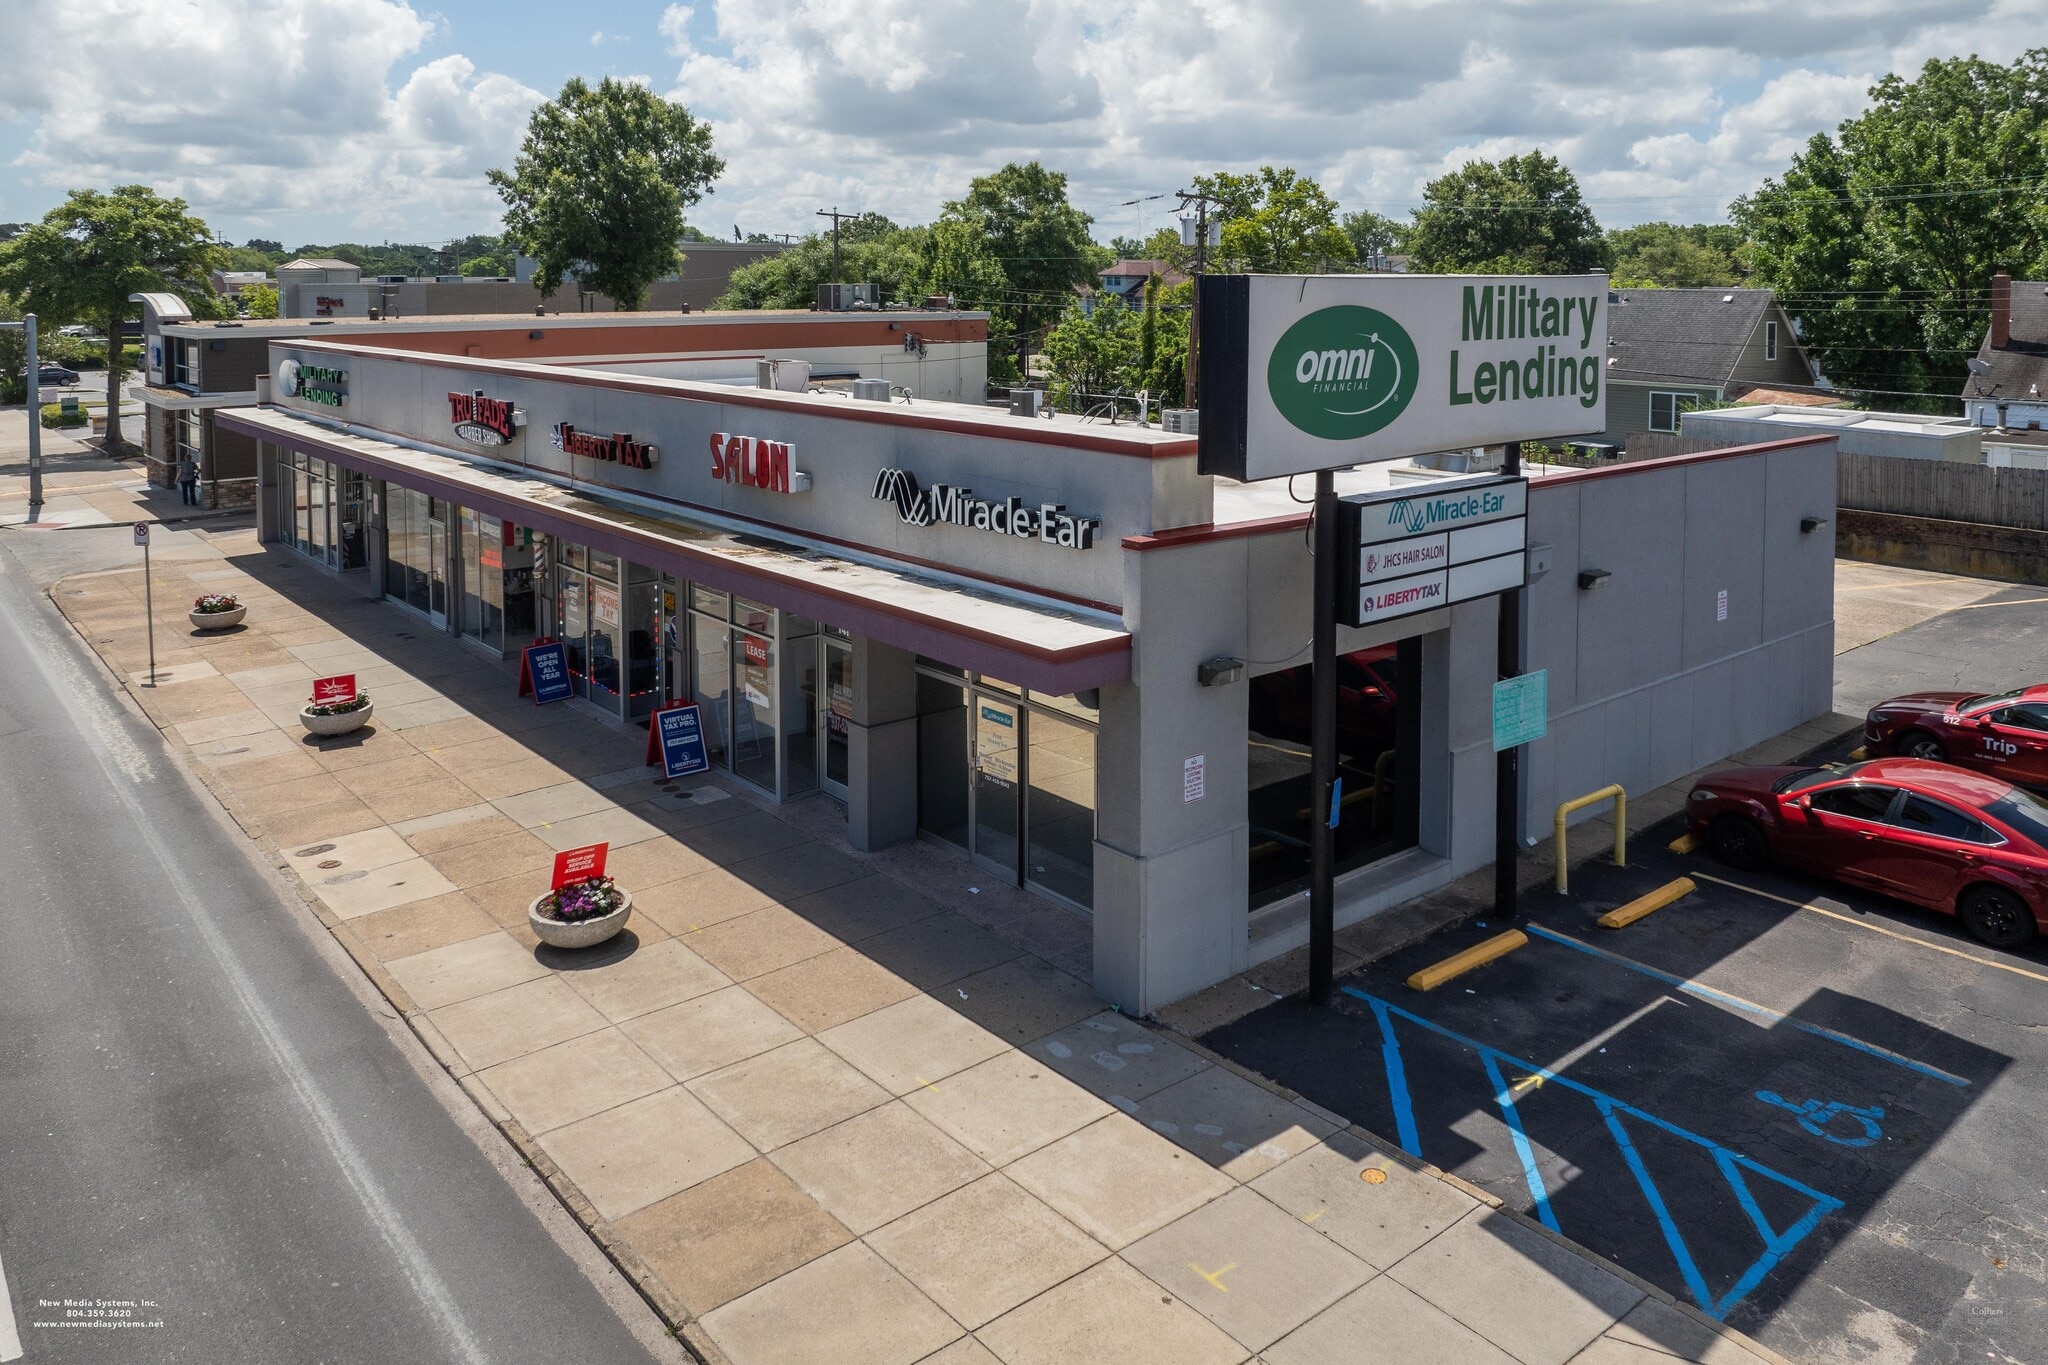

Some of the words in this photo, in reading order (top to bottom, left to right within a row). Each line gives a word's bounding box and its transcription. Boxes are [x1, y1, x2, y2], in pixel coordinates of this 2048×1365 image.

[1462, 285, 1598, 350] Military
[1296, 348, 1375, 383] omni
[301, 365, 339, 384] MILITARY
[1449, 345, 1599, 408] Lending
[1313, 381, 1369, 393] FINANCIAL
[301, 386, 338, 406] LENDING
[448, 392, 473, 424] TRU
[476, 397, 511, 437] FADE
[483, 429, 499, 445] SHOP
[614, 433, 646, 469] TAX
[710, 433, 793, 493] SALON
[931, 484, 1091, 550] Miracle-Ear
[1383, 554, 1401, 569] JHCS
[1402, 549, 1420, 565] HAIR
[1421, 545, 1445, 561] SALON
[597, 594, 618, 610] INCOME
[602, 605, 613, 618] TAX
[535, 652, 559, 662] WE'RE
[746, 644, 767, 660] LEASE
[538, 659, 559, 668] OPEN
[543, 666, 556, 674] ALL
[541, 671, 561, 681] YEAR
[664, 713, 695, 724] VIRTUAL
[664, 722, 678, 730] TAX
[679, 719, 697, 728] PRO.
[1943, 715, 1960, 725] 612
[1982, 736, 2018, 755] Trip
